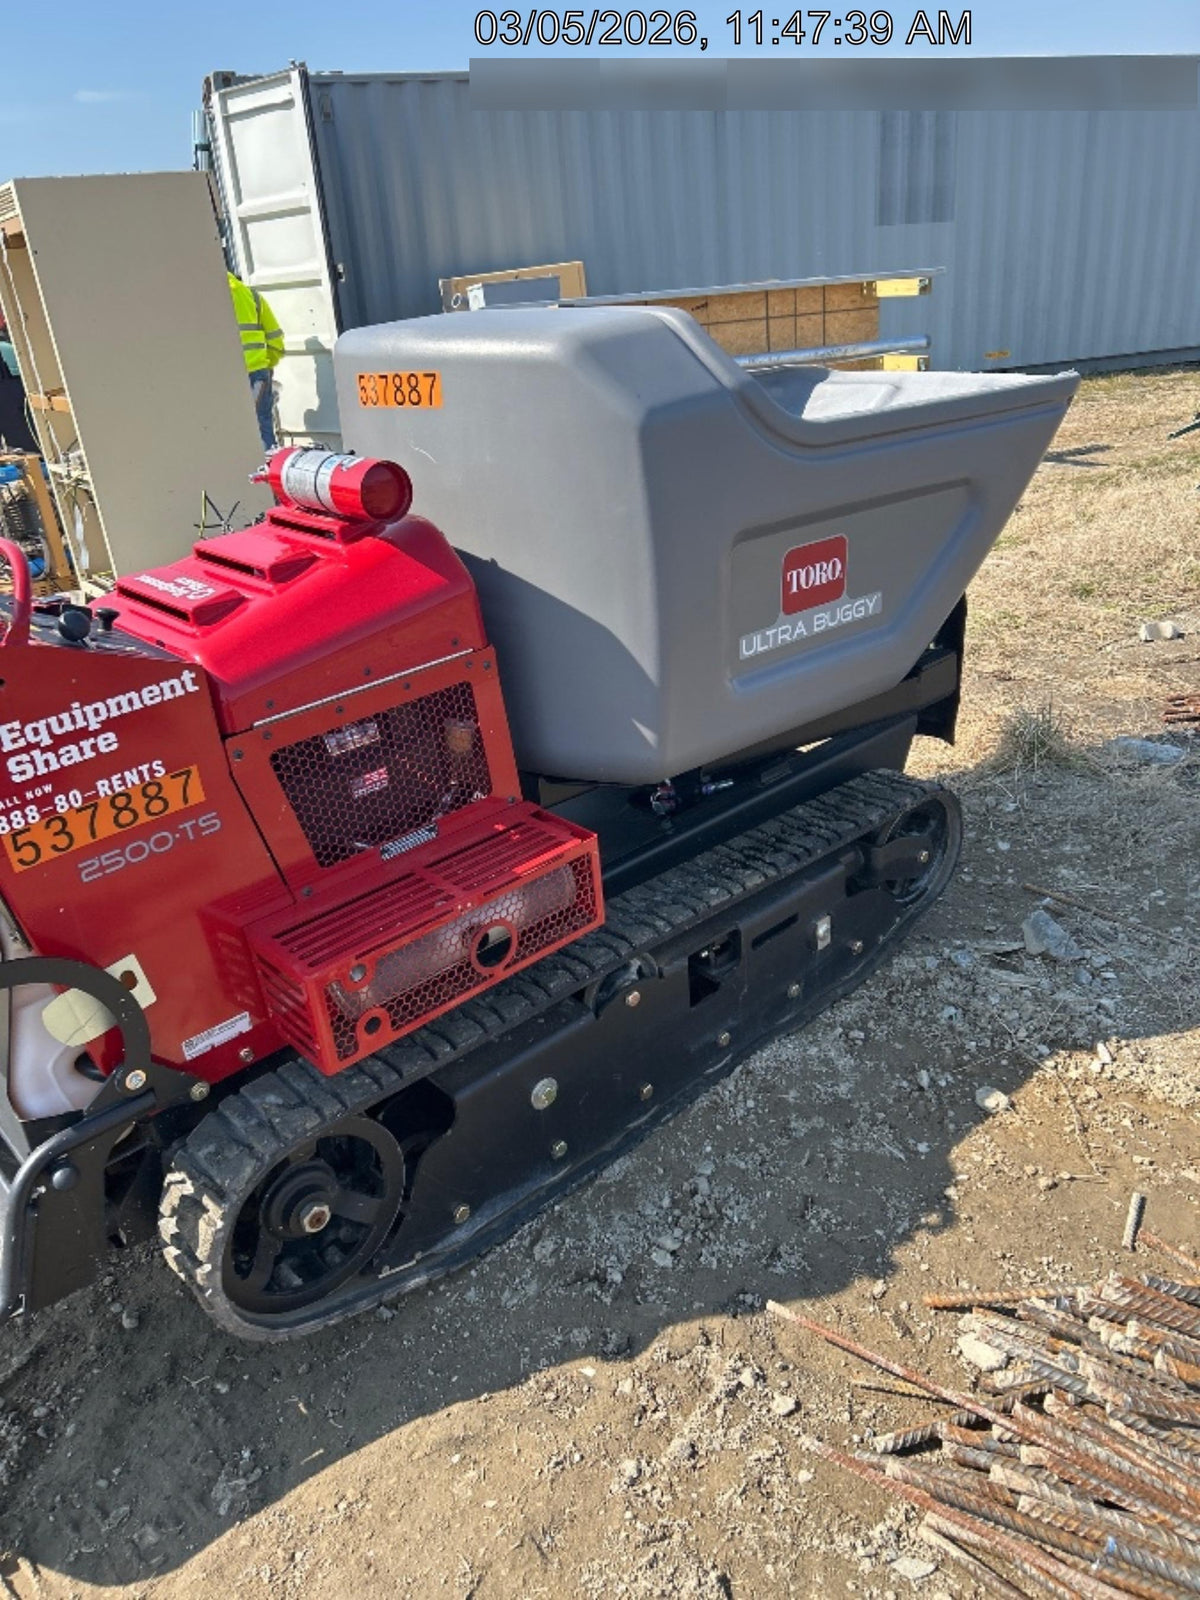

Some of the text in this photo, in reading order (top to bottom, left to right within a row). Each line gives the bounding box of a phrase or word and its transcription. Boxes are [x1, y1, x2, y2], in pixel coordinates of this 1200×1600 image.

[358, 373, 437, 406] 537887
[786, 557, 843, 595] TORO
[742, 595, 878, 656] ULTRA BUGGY
[0, 669, 200, 753] Equipment
[6, 731, 119, 784] Share
[11, 769, 193, 867] 537887
[25, 784, 53, 800] NOW
